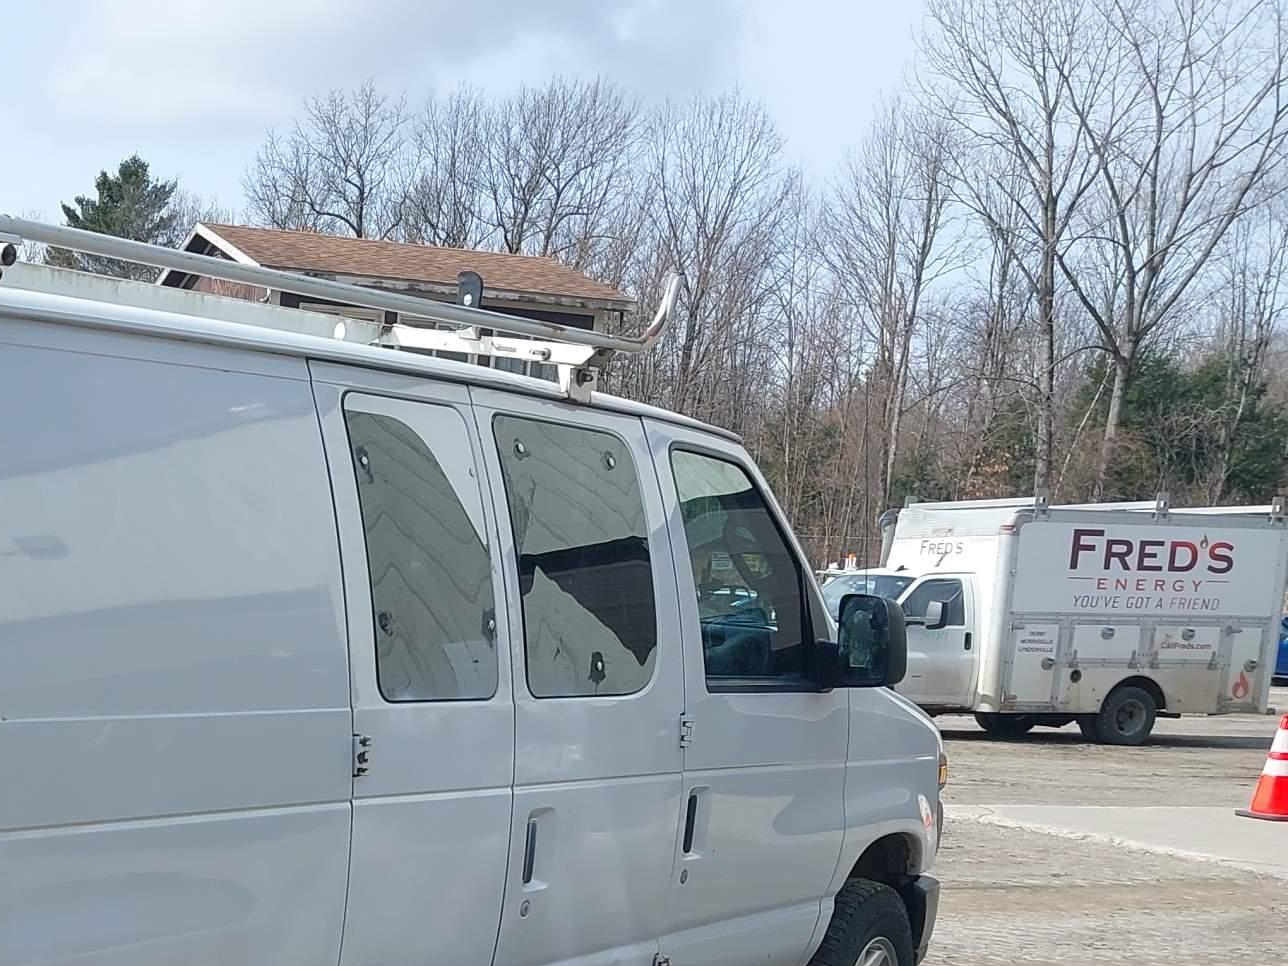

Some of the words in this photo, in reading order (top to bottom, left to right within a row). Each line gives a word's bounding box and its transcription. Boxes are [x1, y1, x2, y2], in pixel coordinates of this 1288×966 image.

[1069, 528, 1234, 574] FRED'S
[1096, 578, 1204, 593] ENERGY
[1073, 595, 1121, 609] YOU'VE
[1125, 596, 1152, 609] GOT
[1154, 597, 1163, 609] A
[1169, 597, 1220, 611] FRIEND
